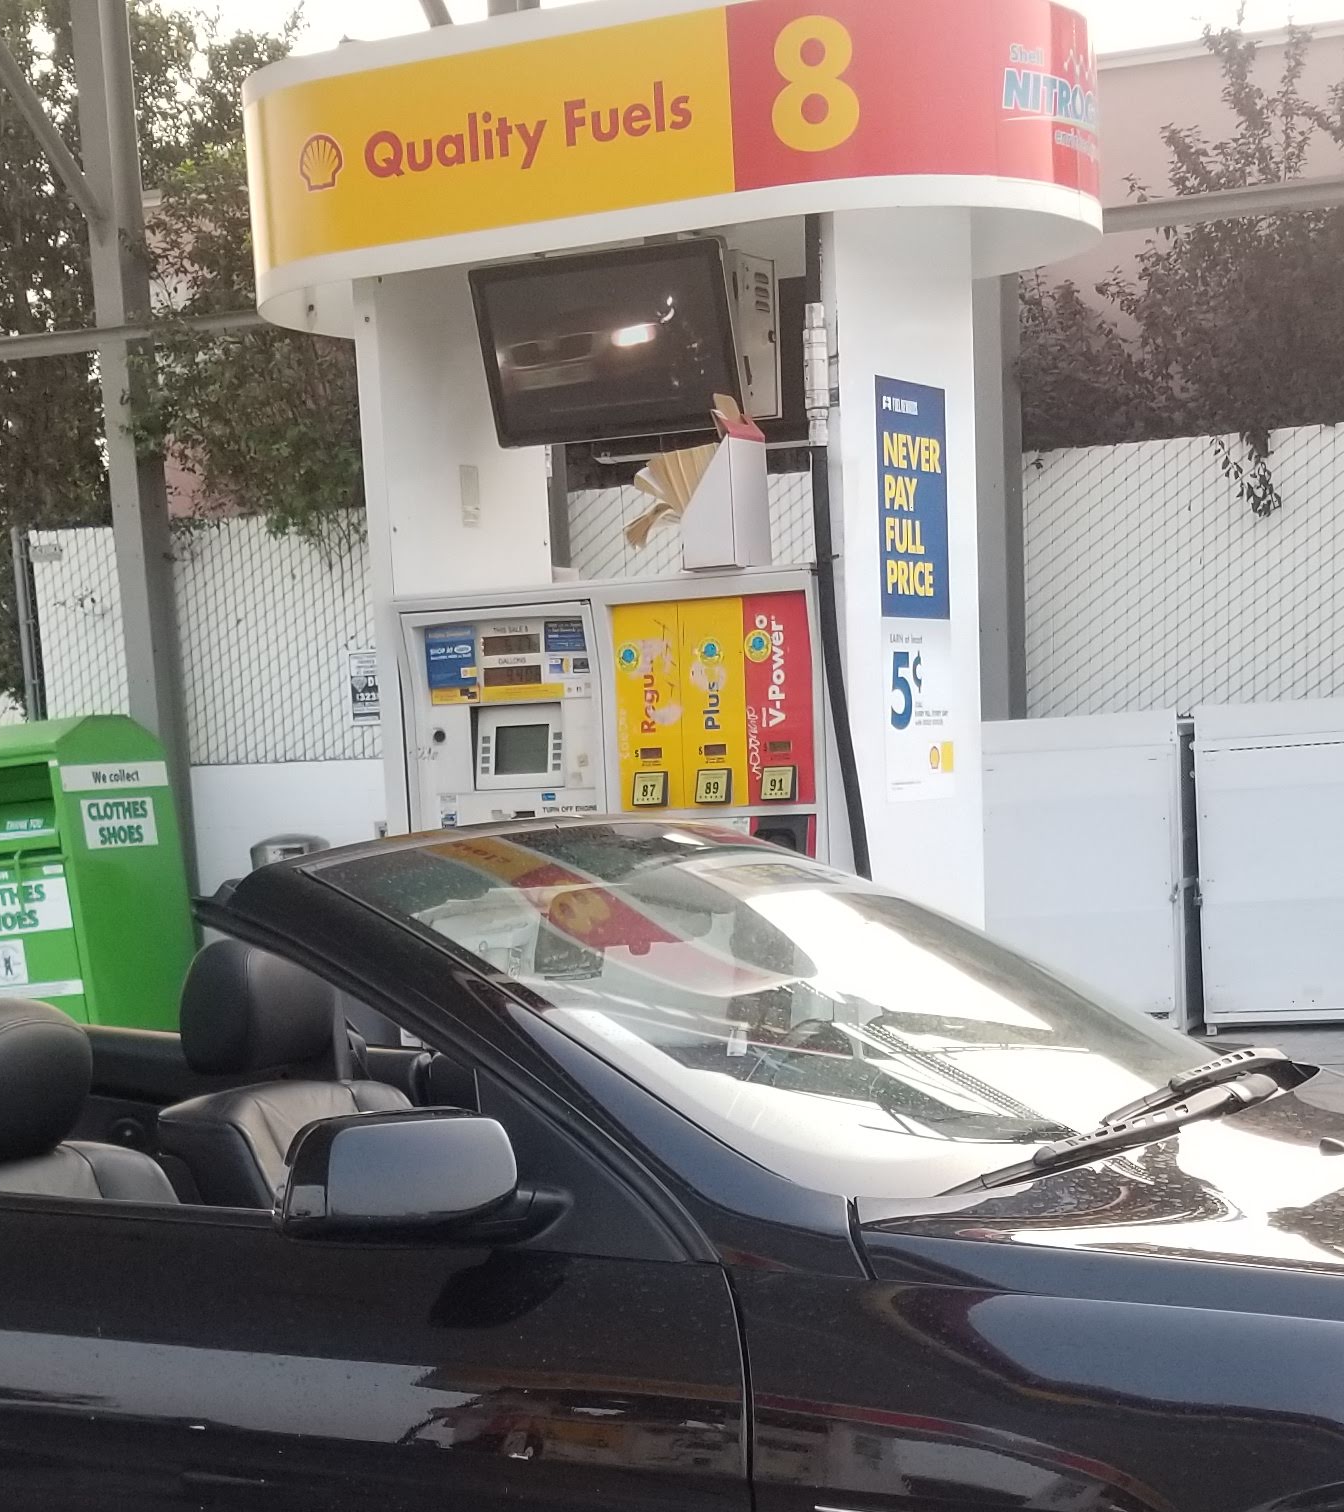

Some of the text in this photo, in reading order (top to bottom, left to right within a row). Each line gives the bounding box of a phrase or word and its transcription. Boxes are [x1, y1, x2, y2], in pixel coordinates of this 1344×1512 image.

[1009, 43, 1045, 67] Shell
[771, 15, 859, 152] 8
[364, 81, 693, 178] Quality Fuels
[883, 431, 942, 474] NEVER
[884, 474, 918, 512] PAY
[885, 516, 925, 556] FULL
[886, 559, 934, 597] PRICE
[768, 617, 786, 728] V-Power
[92, 769, 140, 784] We collect
[642, 783, 656, 797] 87
[704, 781, 719, 795] 89
[769, 777, 784, 792] 91
[87, 800, 148, 821] CLOTHES
[98, 825, 144, 846] SHOES
